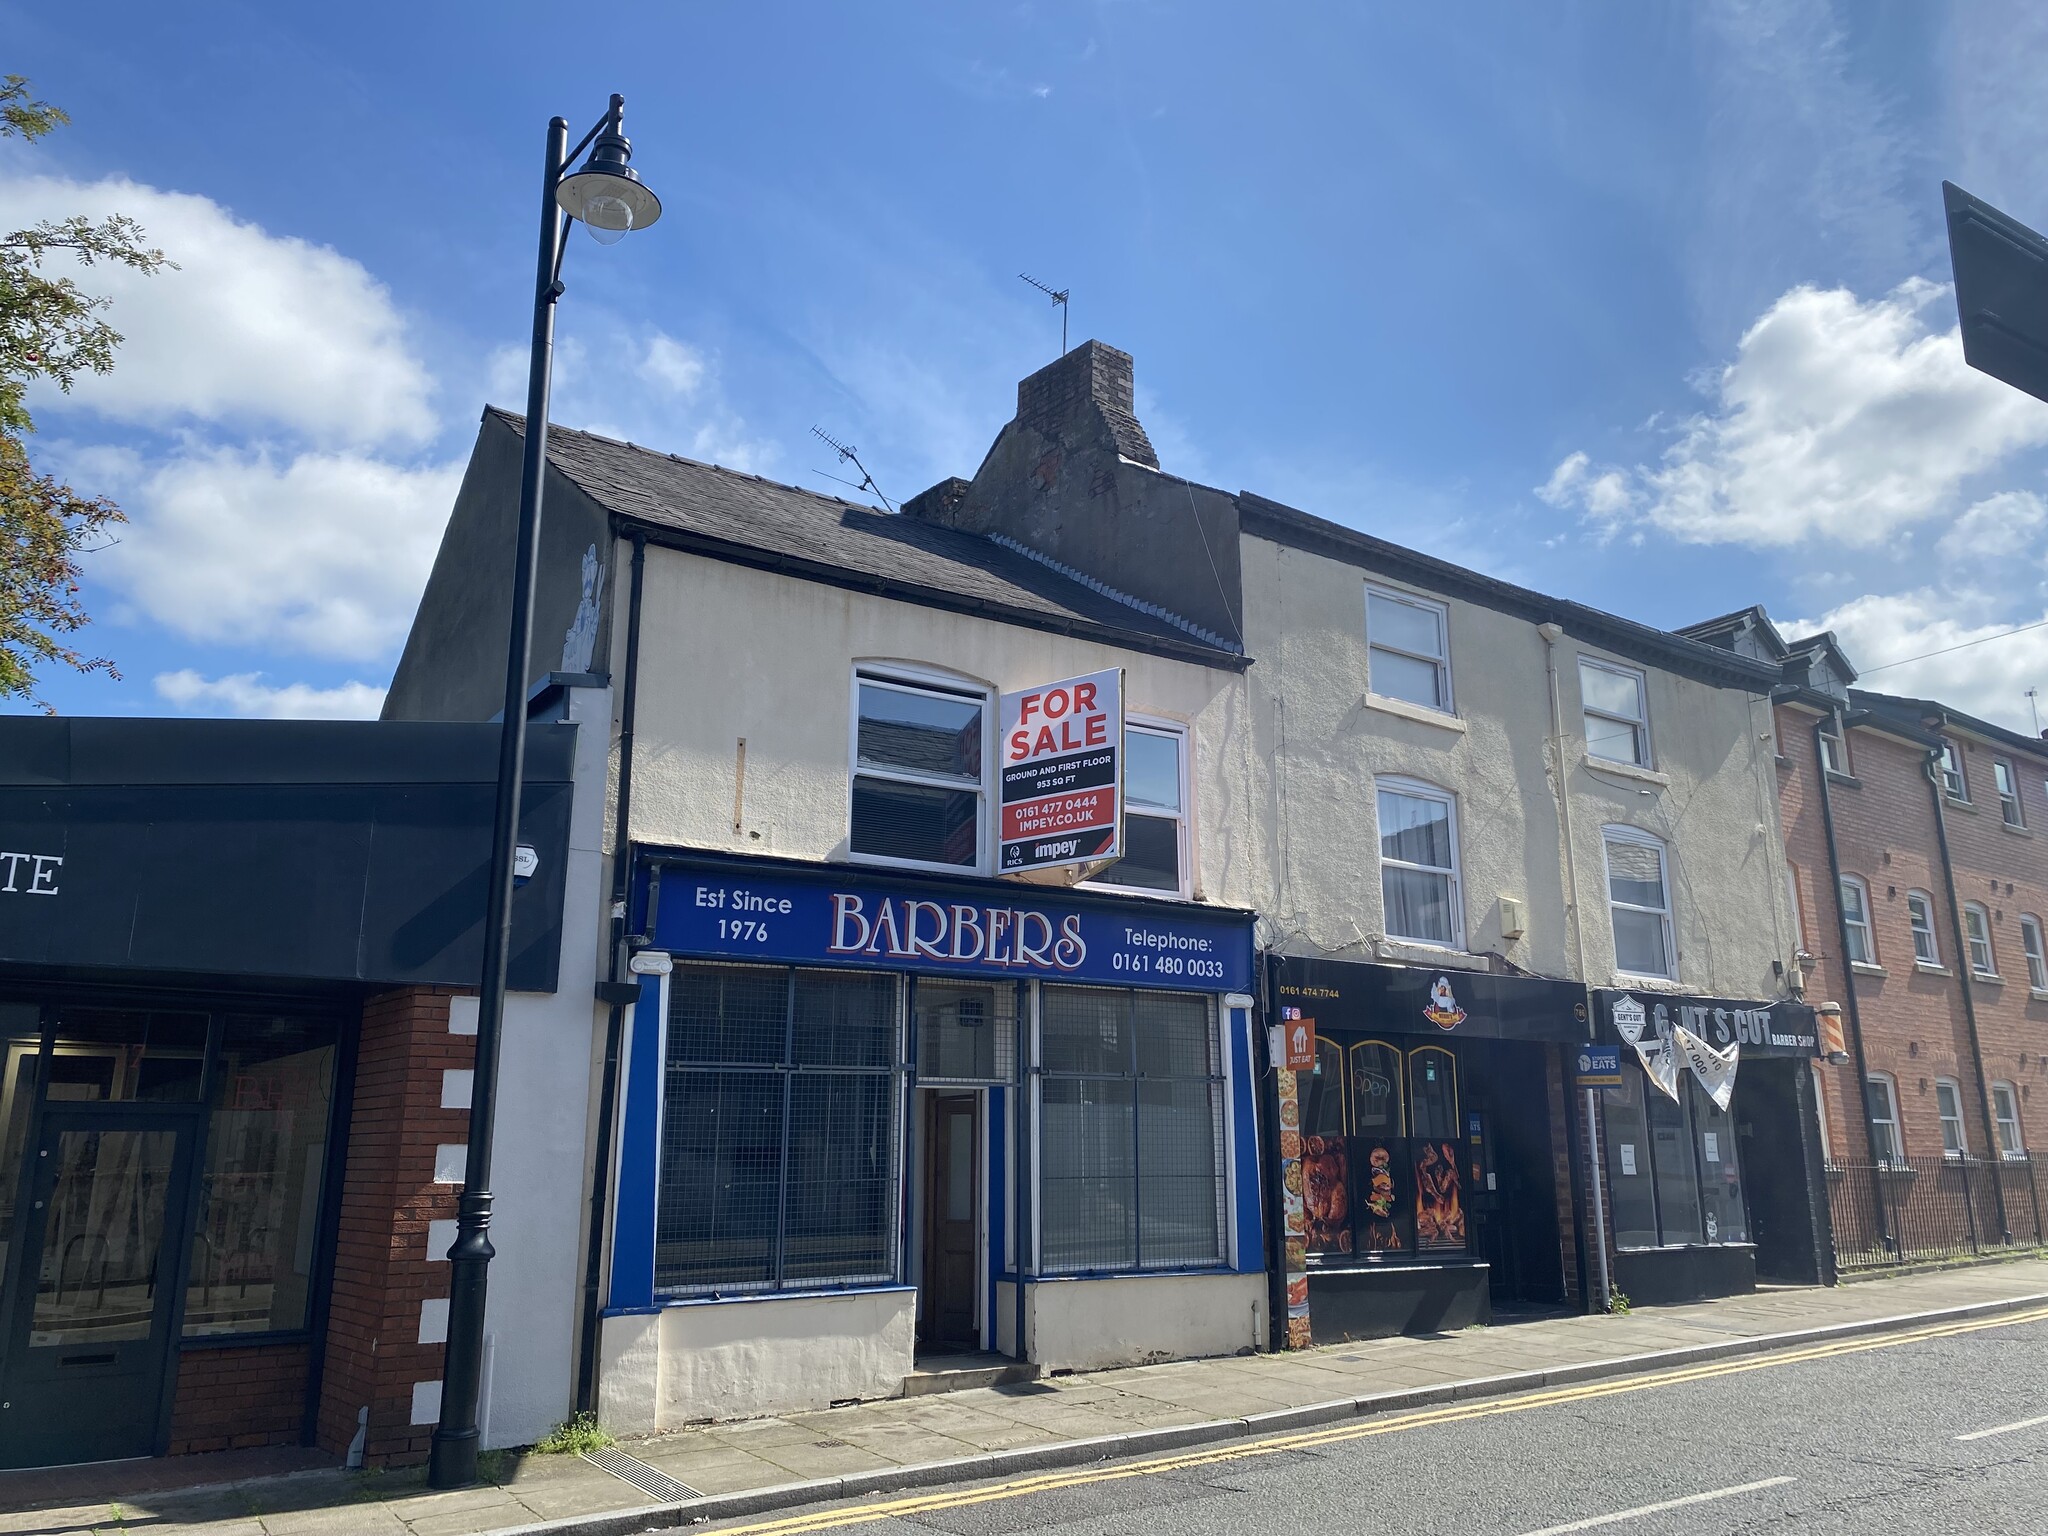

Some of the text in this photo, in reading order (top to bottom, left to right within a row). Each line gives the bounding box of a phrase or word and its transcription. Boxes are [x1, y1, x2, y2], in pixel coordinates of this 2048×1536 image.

[1021, 682, 1097, 725] FOR
[1010, 713, 1107, 761] SALE
[1005, 755, 1112, 782] GROUND AND FIRST FLOOR
[1036, 775, 1076, 789] 953 SQ FT
[1015, 795, 1098, 820] 0161 477 0444
[1019, 809, 1094, 832] IMPEY.CO.UK
[1035, 840, 1077, 859] impey
[0, 851, 63, 895] TE
[1007, 858, 1023, 866] RICS
[695, 886, 793, 914] Est Since
[718, 919, 768, 942] 1976
[828, 893, 1087, 969] BARBERS
[1125, 928, 1212, 952] Telephone:
[1112, 952, 1224, 978] 0161 480 0033
[1280, 985, 1340, 998] 0161 474 7744
[1734, 1009, 1772, 1045] CUT
[1771, 1033, 1815, 1047] BARBER SHOP
[1290, 1055, 1311, 1065] JUST EAT
[1592, 1061, 1616, 1069] EATS
